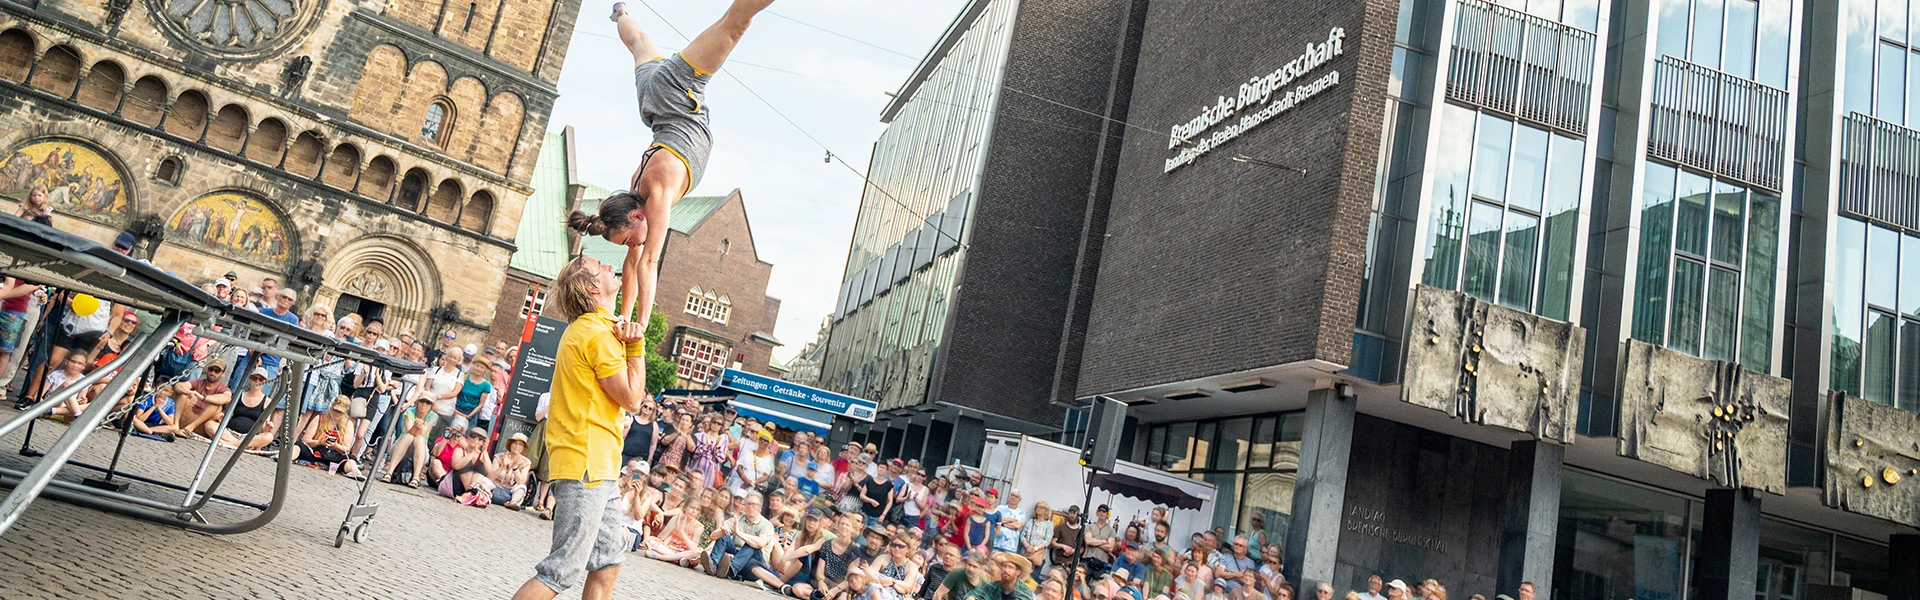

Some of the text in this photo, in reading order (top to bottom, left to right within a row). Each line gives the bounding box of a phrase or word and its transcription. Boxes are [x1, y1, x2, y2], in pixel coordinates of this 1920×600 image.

[1168, 26, 1346, 150] Bremische Bürgerschaft
[1195, 138, 1212, 156] der
[1211, 124, 1239, 148] Freien
[1239, 91, 1295, 133] Hansestadt
[1294, 70, 1340, 104] Bremen
[732, 375, 846, 409] Zeitungen Getränke Souvenirs
[1348, 504, 1386, 523] LANDTAG
